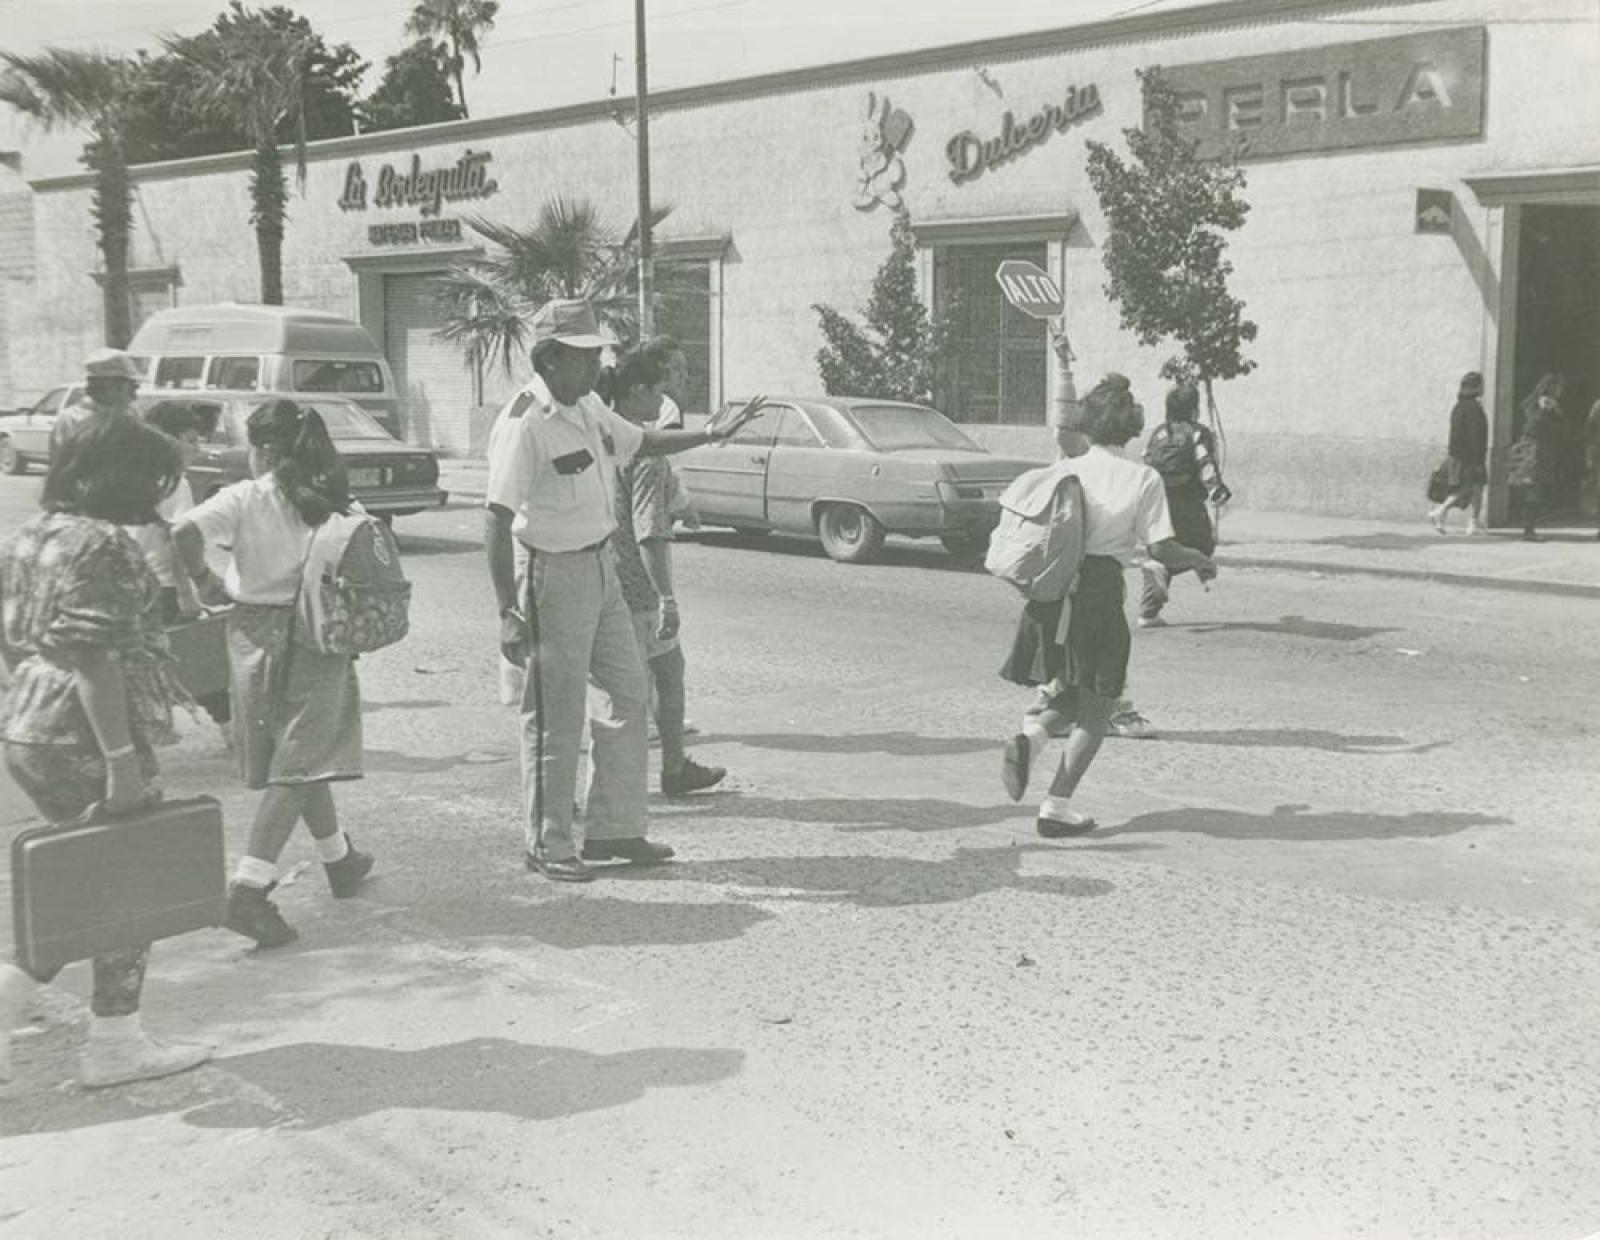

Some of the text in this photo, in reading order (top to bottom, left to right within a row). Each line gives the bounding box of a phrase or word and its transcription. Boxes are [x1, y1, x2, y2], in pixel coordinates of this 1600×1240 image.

[1171, 61, 1453, 131] PERLA
[337, 149, 498, 216] La Bodeguita
[1003, 273, 1061, 304] ALTO
